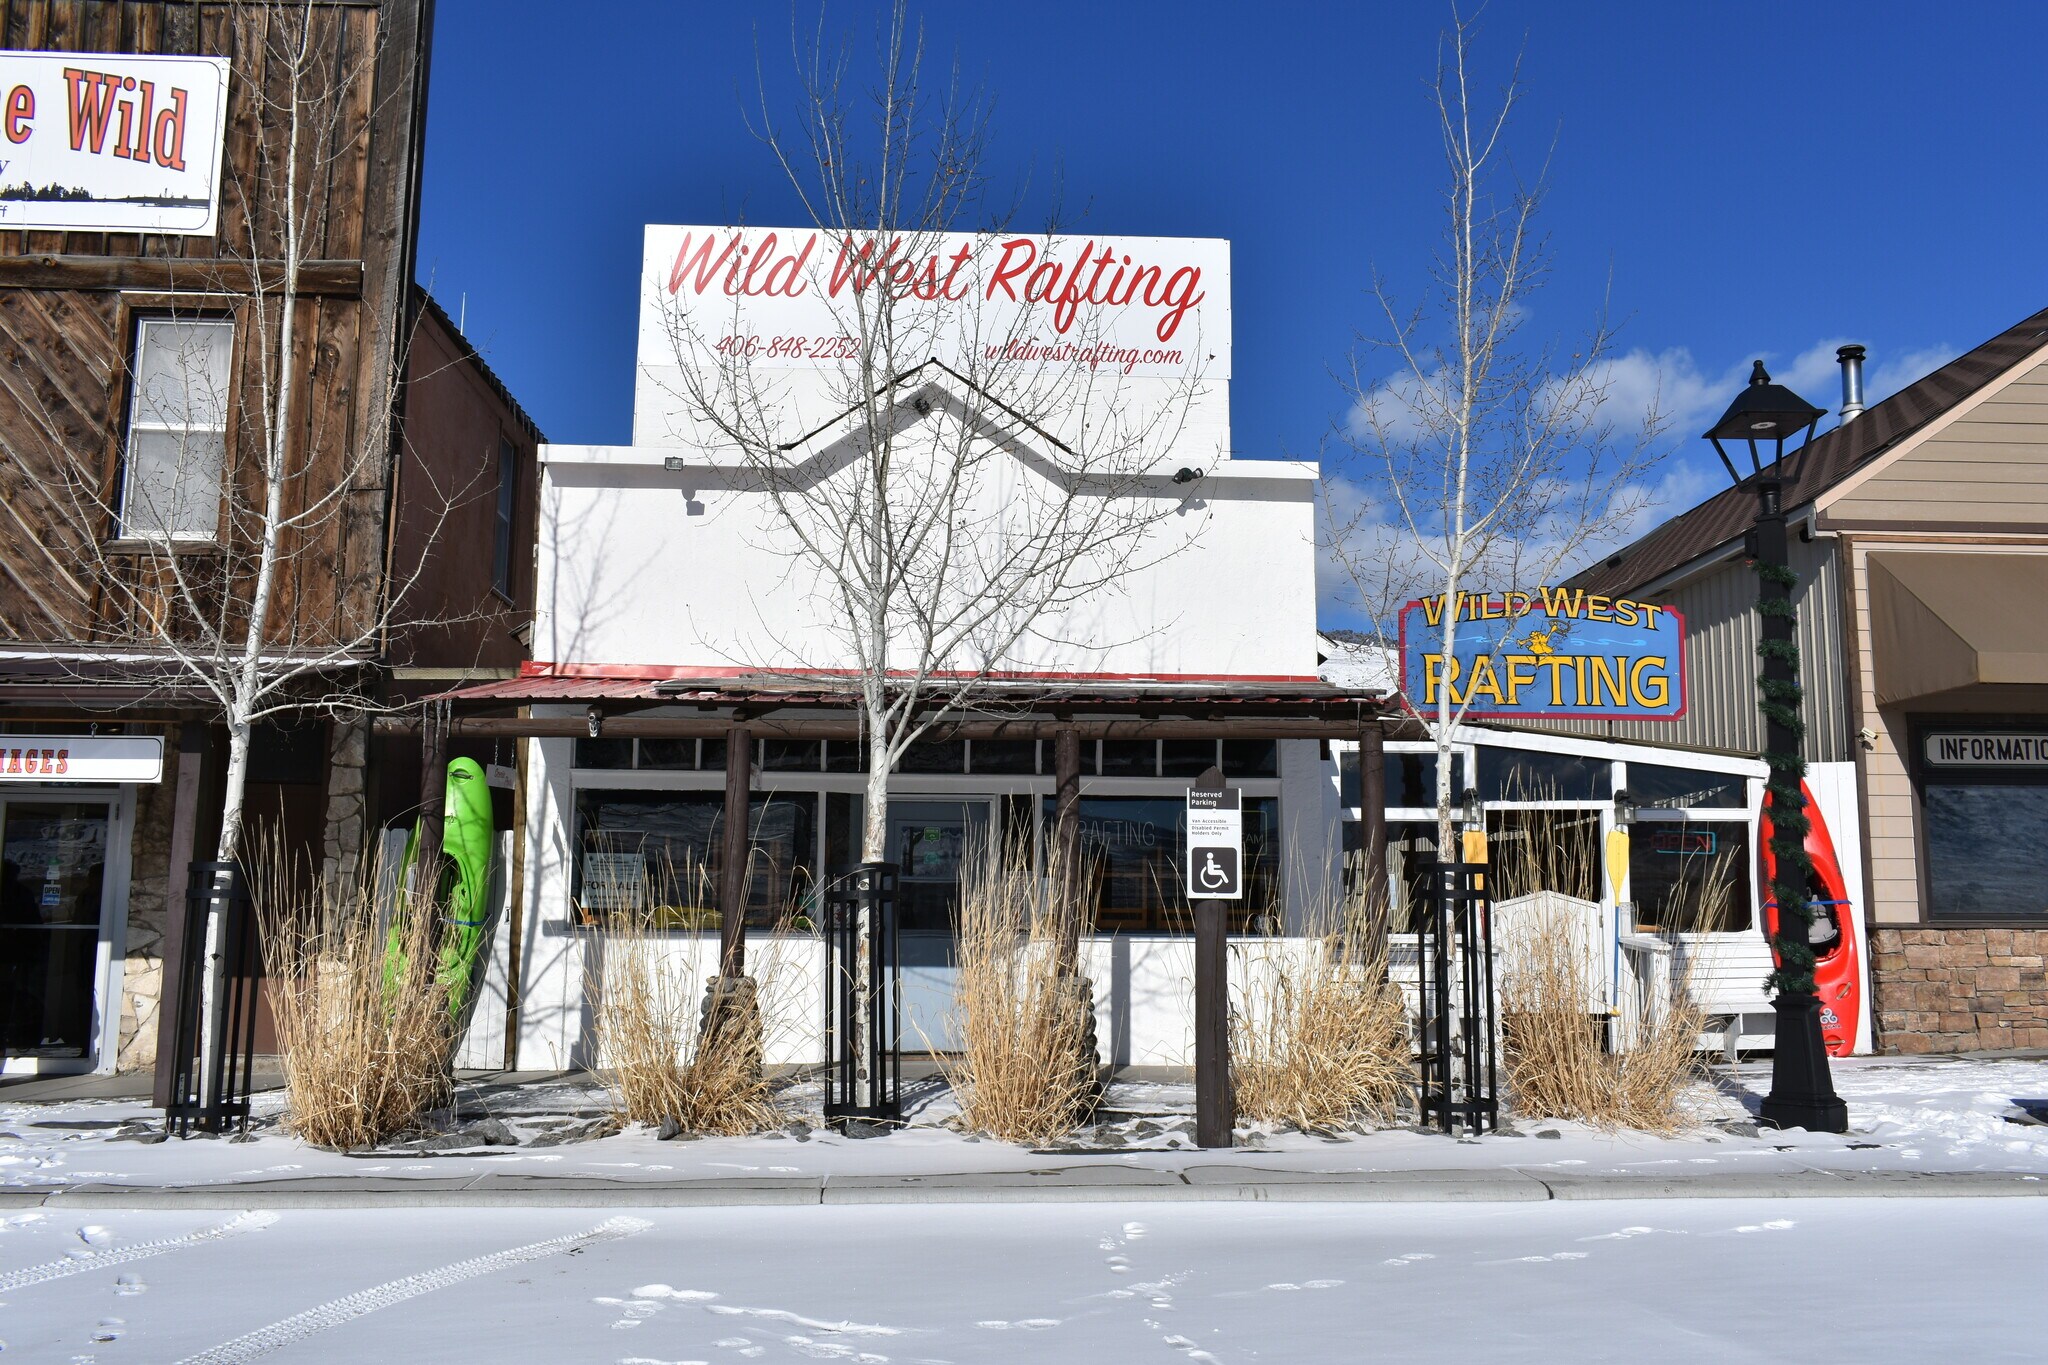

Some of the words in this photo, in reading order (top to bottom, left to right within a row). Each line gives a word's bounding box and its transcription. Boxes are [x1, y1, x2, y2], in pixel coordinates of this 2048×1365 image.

[1, 84, 36, 145] e
[63, 67, 188, 172] Wild
[669, 231, 817, 297] Wild
[828, 235, 974, 301] West
[986, 239, 1205, 345] Rafting
[714, 335, 861, 359] 406-848-2252
[1419, 590, 1532, 627] WILD
[1539, 585, 1664, 632] WEST
[1422, 653, 1671, 708] RAFTING
[1191, 799, 1217, 807] Parking
[1079, 820, 1155, 846] RAFTING
[44, 886, 60, 894] OPEN
